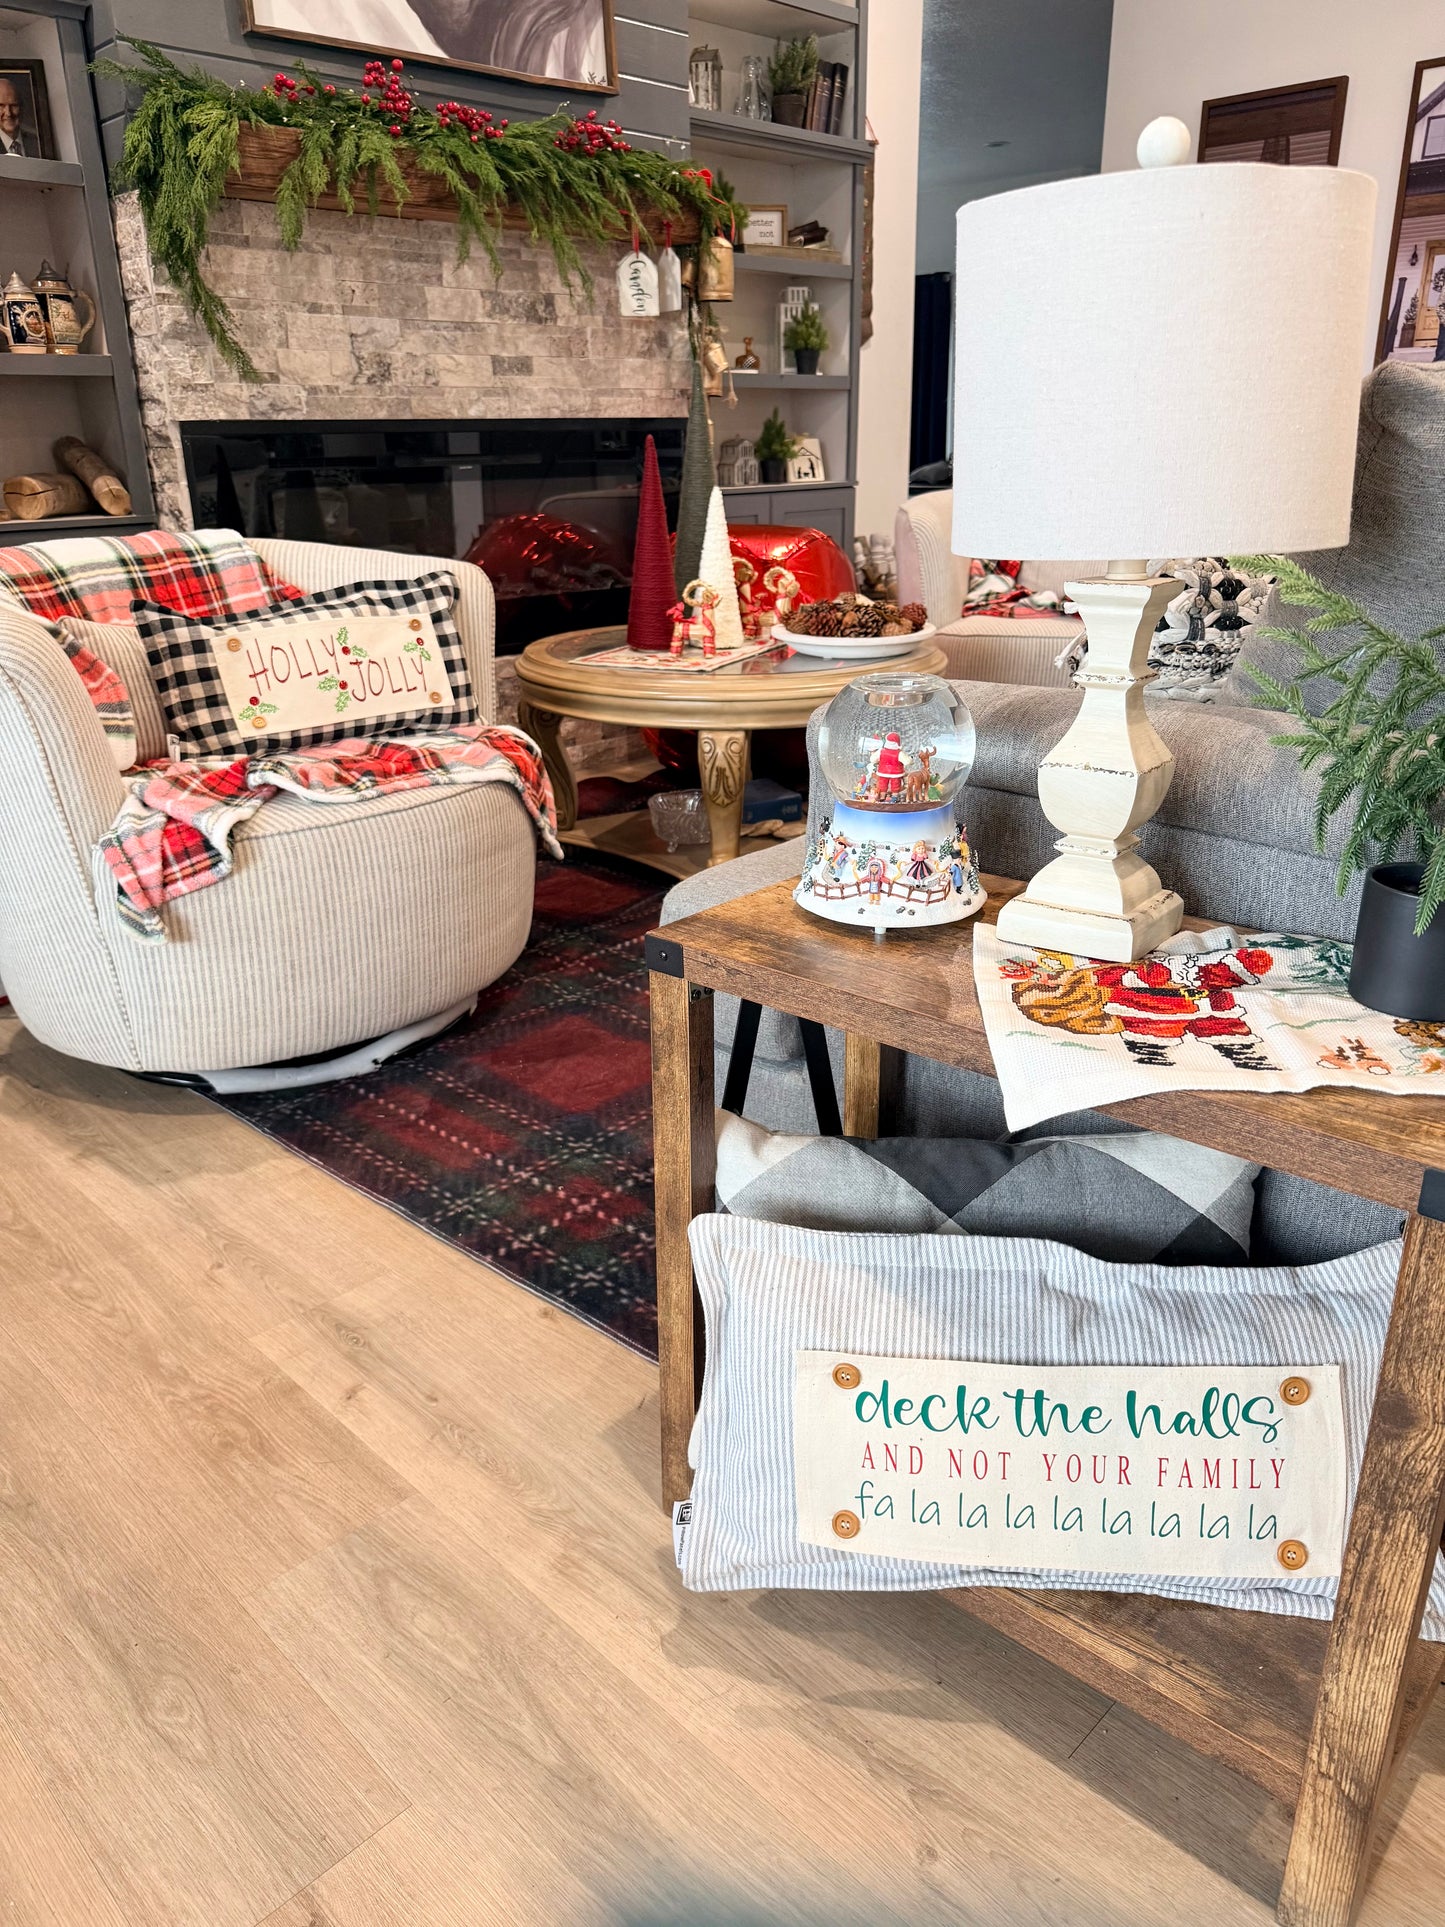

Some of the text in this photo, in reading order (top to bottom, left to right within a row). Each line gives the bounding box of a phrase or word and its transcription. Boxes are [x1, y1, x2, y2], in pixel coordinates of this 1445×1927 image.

[246, 634, 340, 697] HOLLY
[350, 655, 427, 702] JOLLY
[855, 1379, 1284, 1444] deck the halls
[861, 1441, 1286, 1489] AND NOT YOUR FAMILY
[854, 1480, 1278, 1540] fa la la la la la la la la
